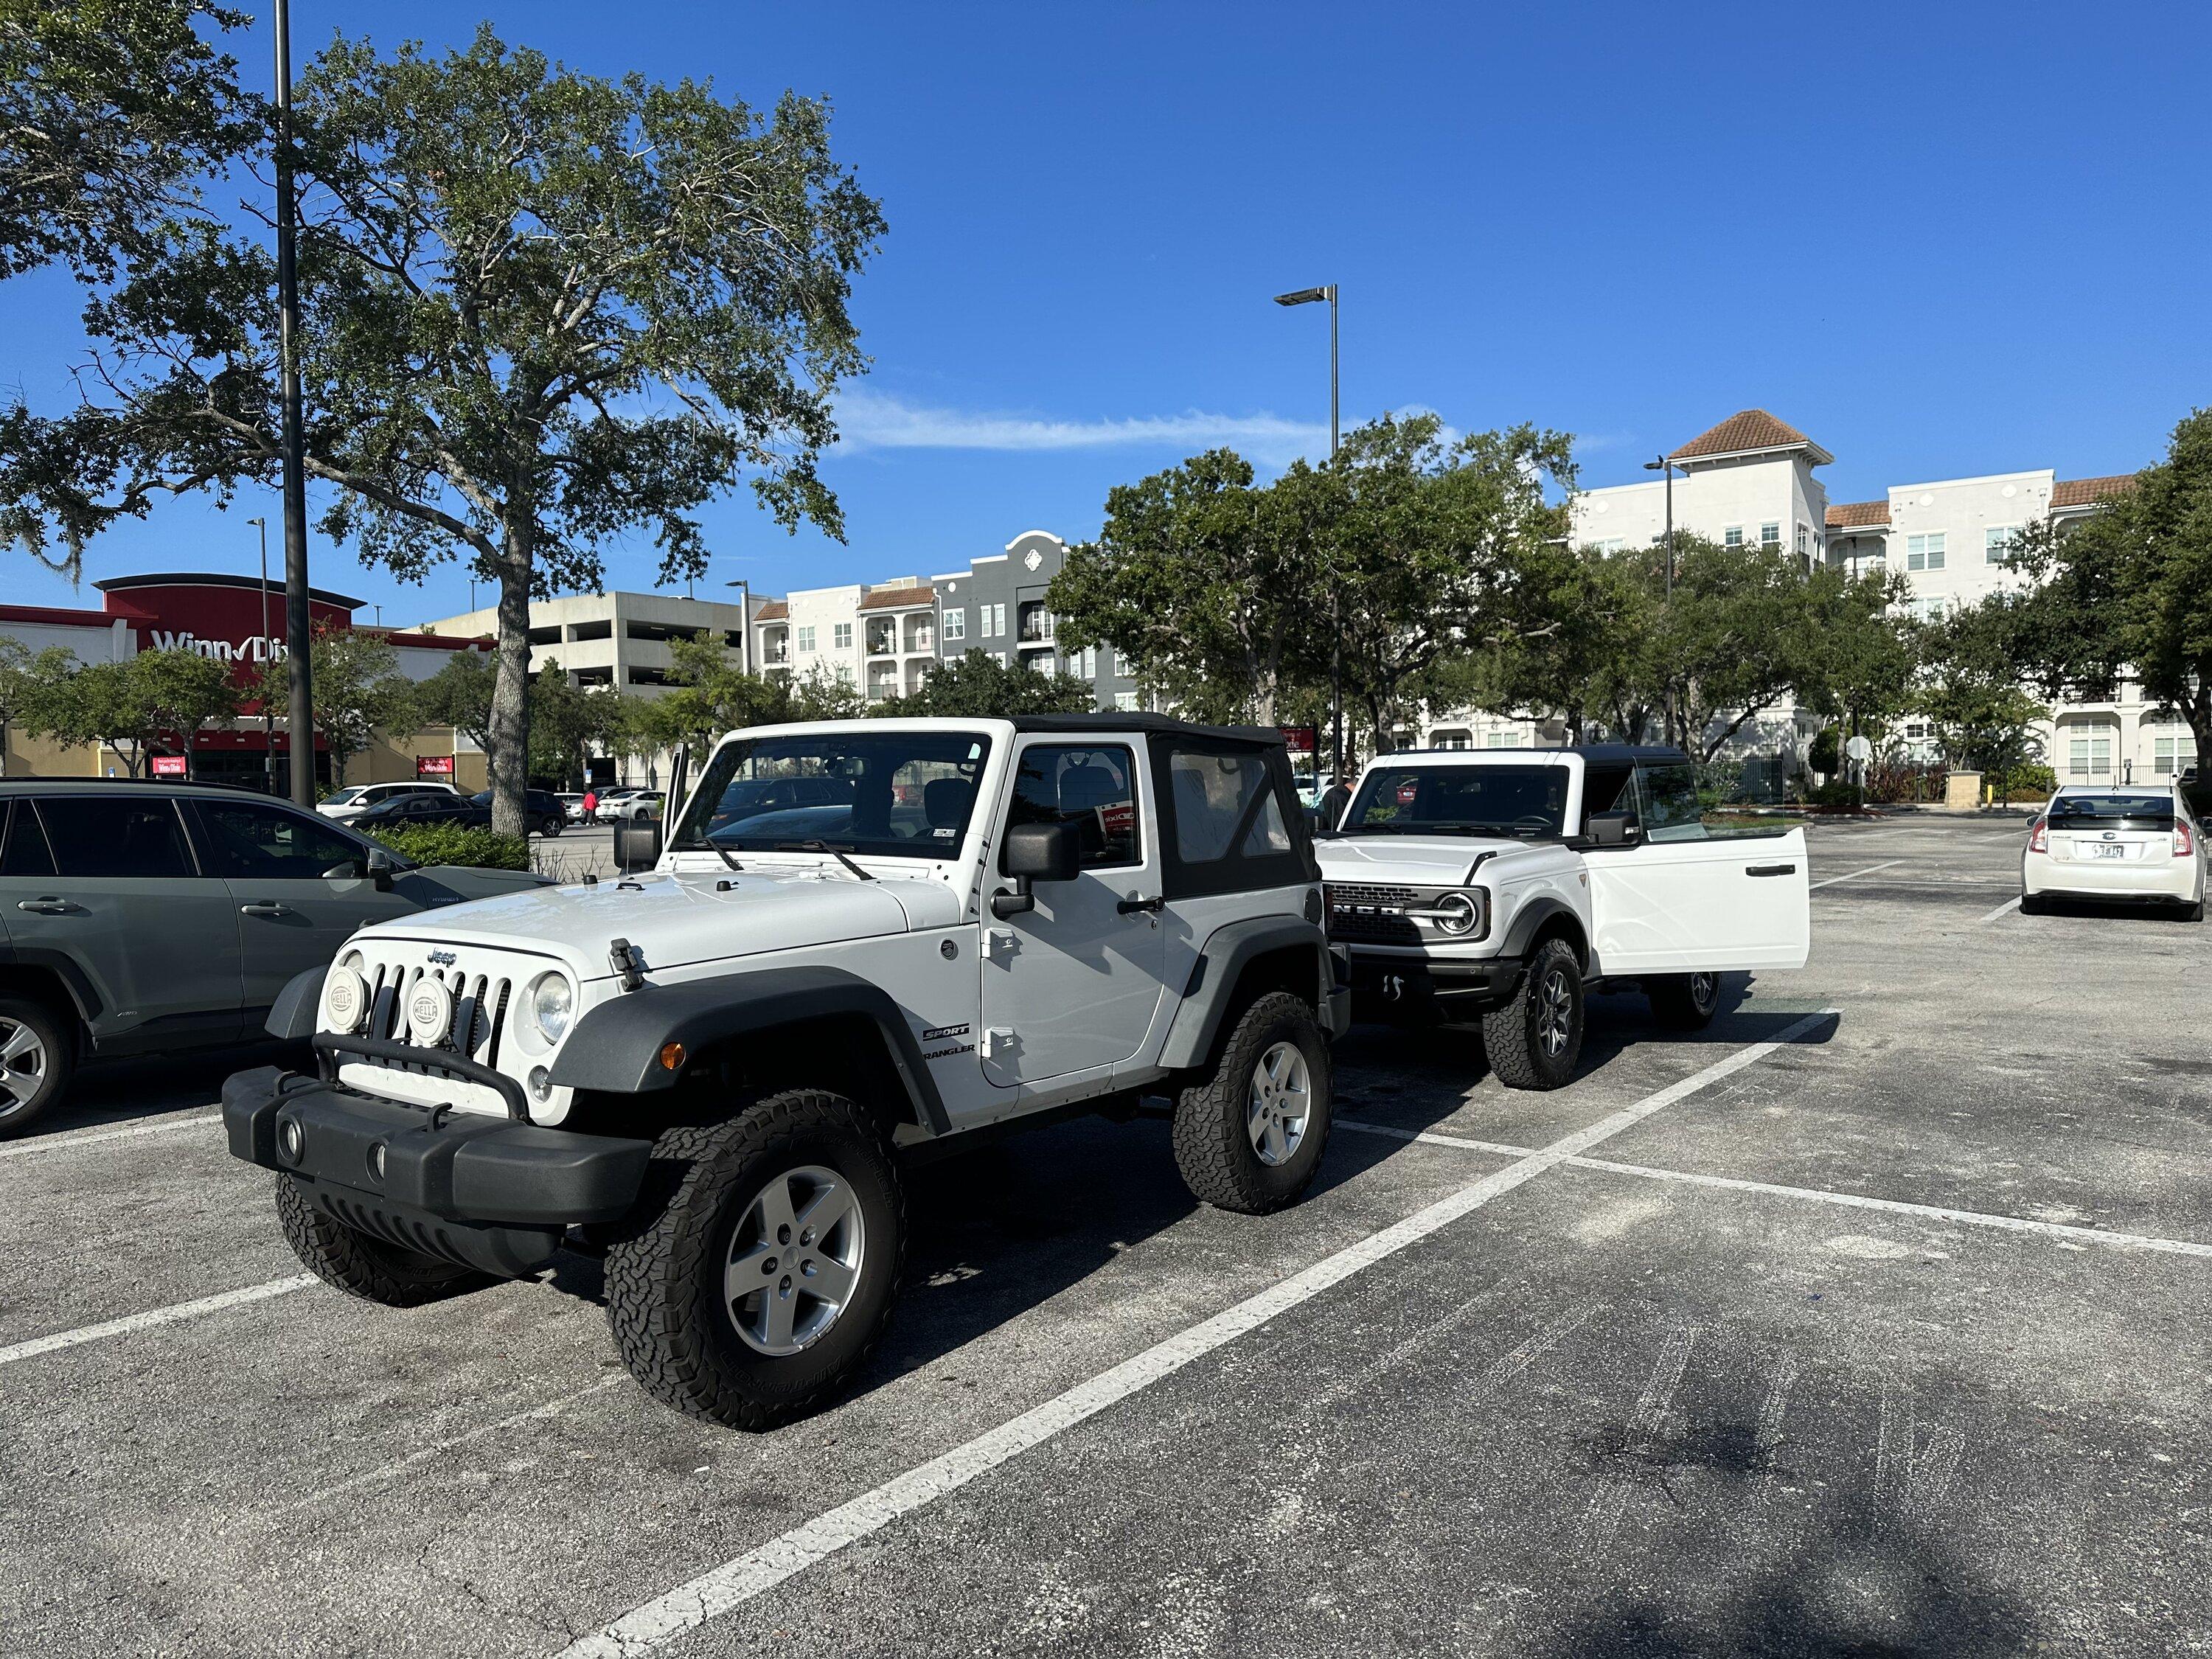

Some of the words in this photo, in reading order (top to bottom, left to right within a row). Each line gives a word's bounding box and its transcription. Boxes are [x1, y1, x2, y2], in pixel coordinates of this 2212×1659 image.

[150, 630, 232, 661] Winn
[1333, 905, 1400, 915] NCO
[428, 947, 457, 968] Jeep
[332, 993, 352, 1004] HELLA
[414, 1005, 438, 1020] HELLA
[925, 1026, 969, 1039] SPORT
[923, 1044, 975, 1060] RANGLER
